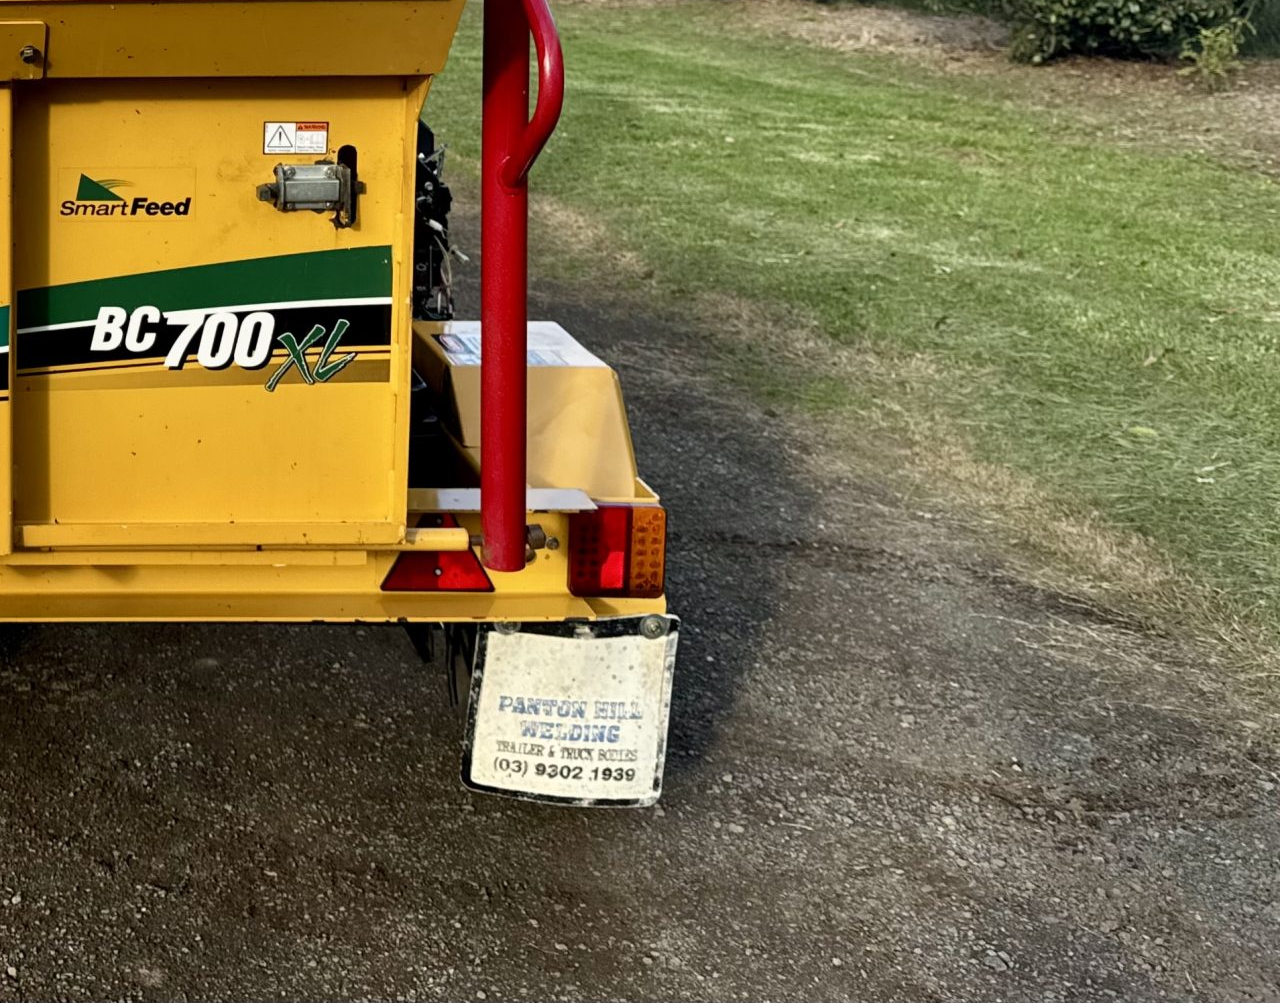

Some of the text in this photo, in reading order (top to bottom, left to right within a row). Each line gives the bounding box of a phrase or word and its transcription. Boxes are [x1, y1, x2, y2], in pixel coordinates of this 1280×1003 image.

[498, 695, 643, 720] PANTON HILL
[520, 719, 620, 743] WELDING
[496, 740, 545, 757] TRAILER
[547, 747, 555, 758] &
[560, 747, 595, 762] TRUCK
[494, 757, 636, 782] (03) 9302 1939
